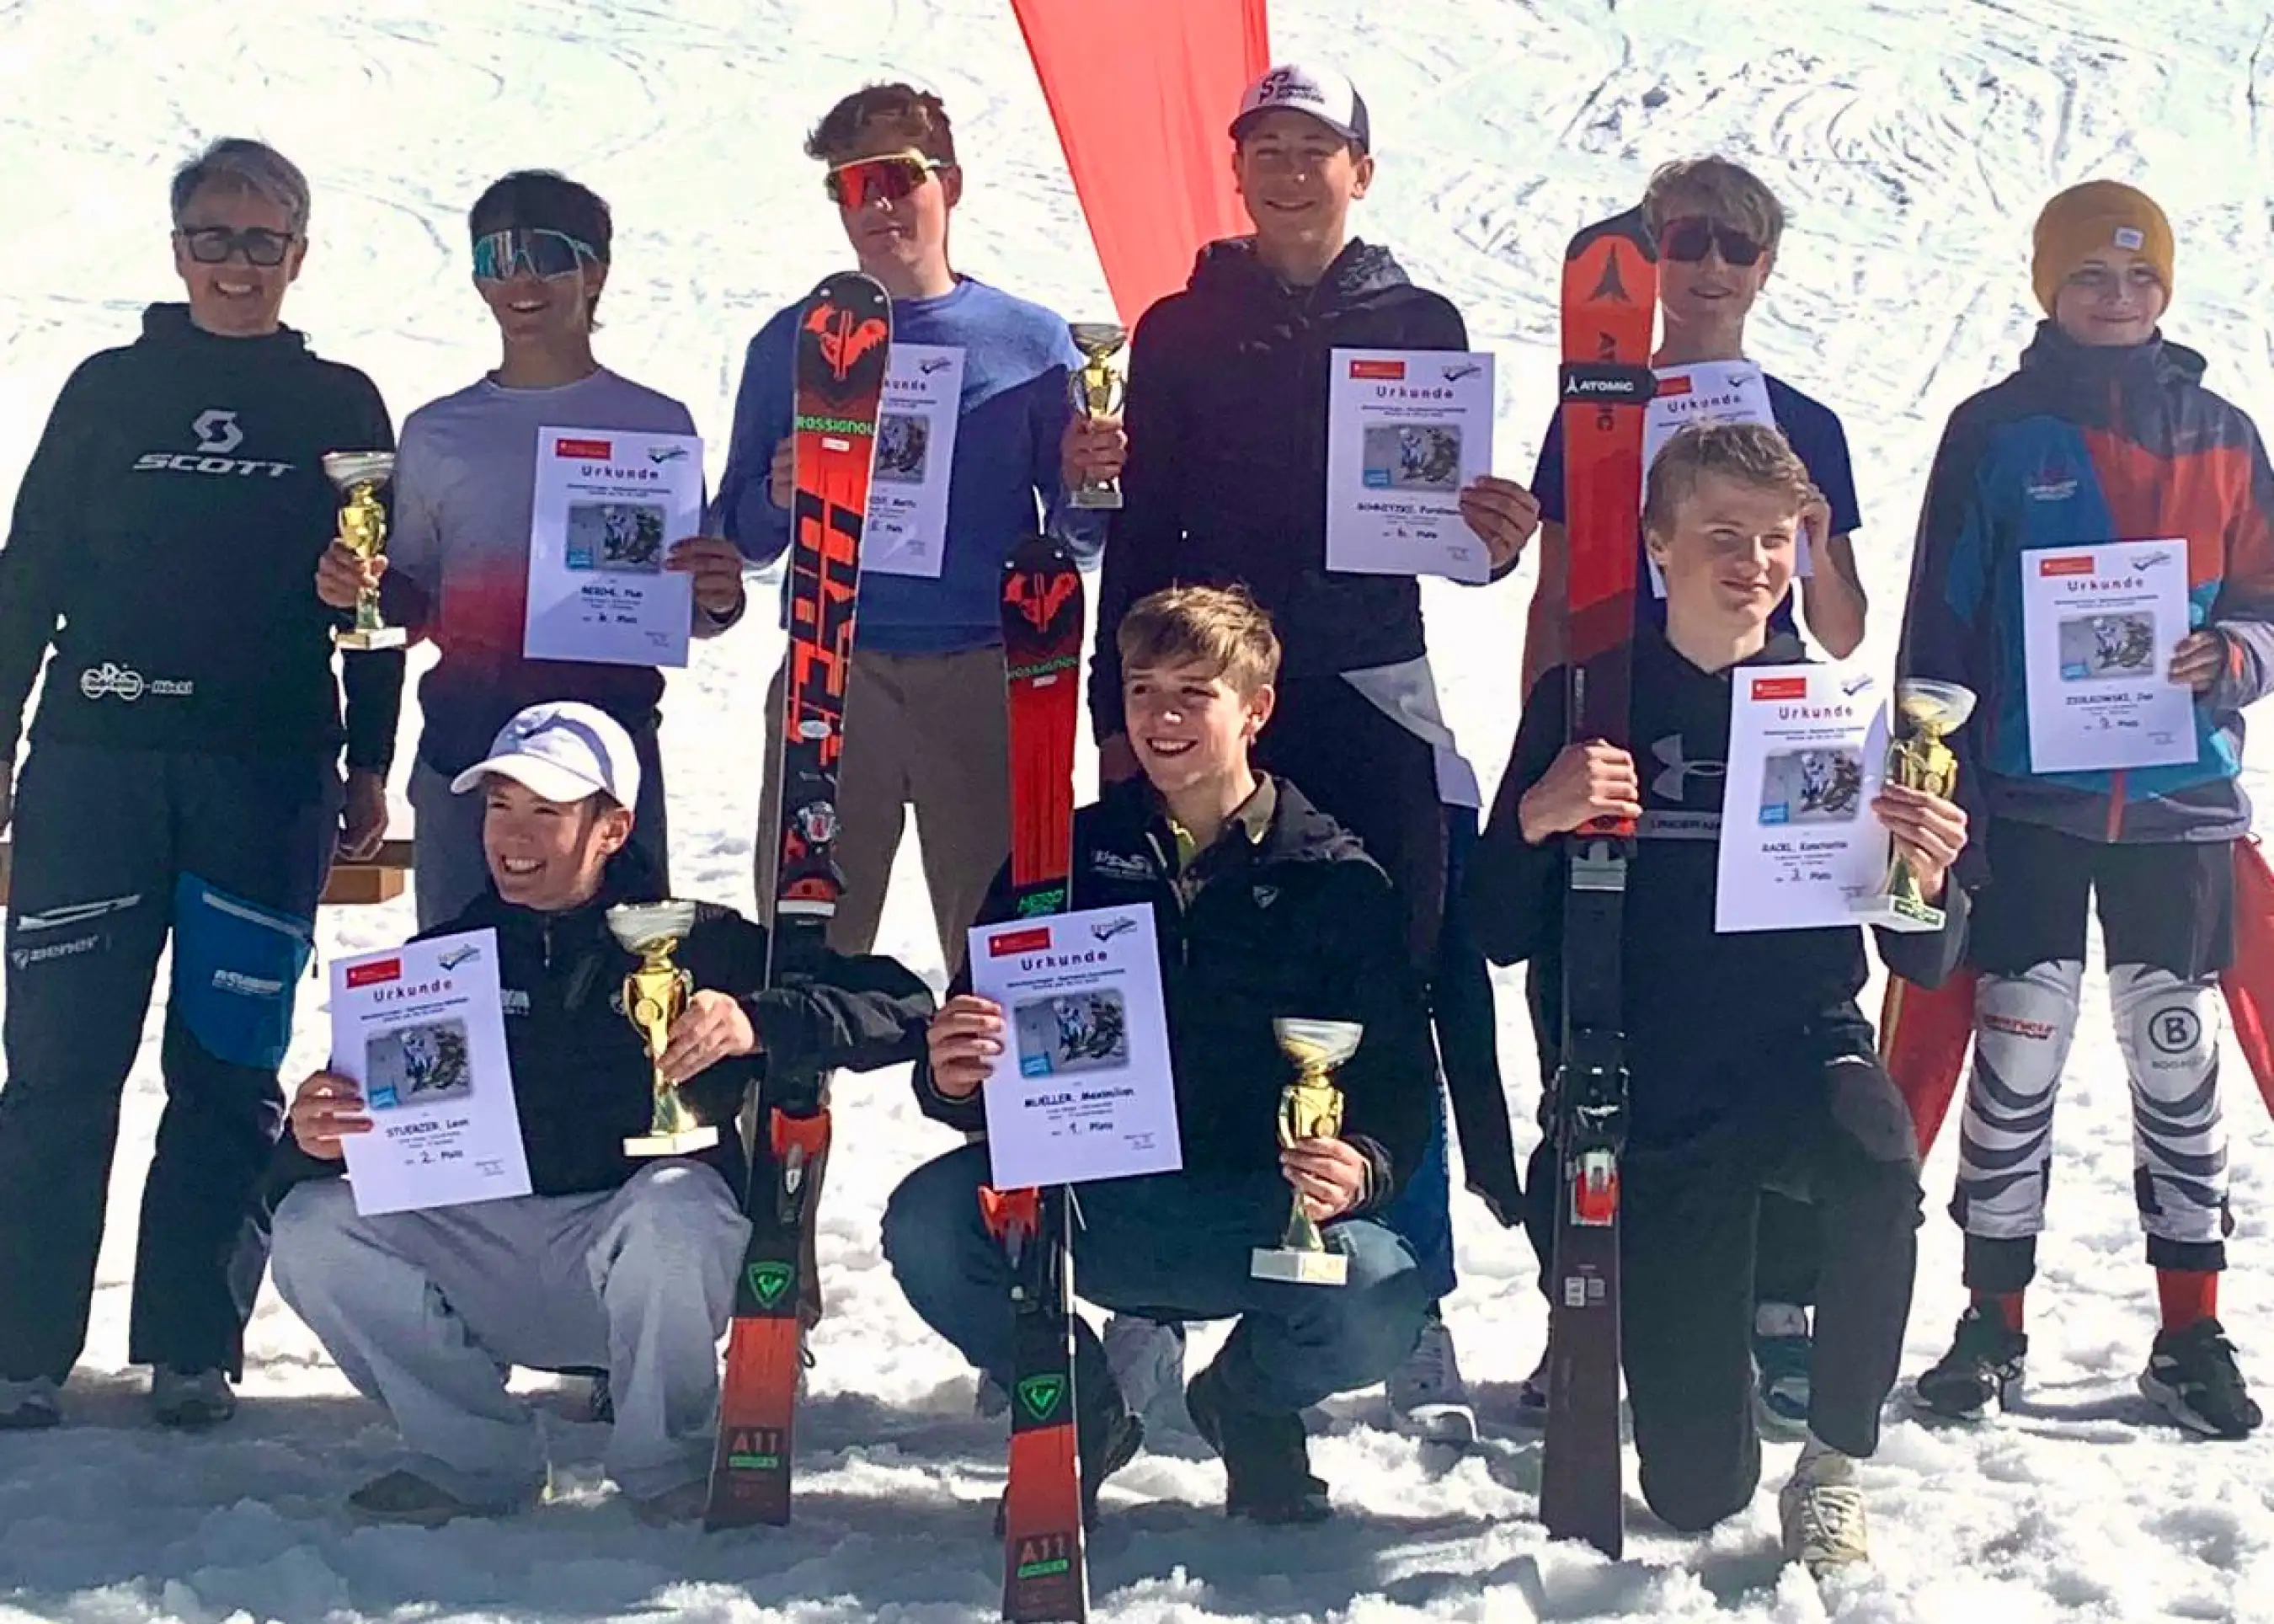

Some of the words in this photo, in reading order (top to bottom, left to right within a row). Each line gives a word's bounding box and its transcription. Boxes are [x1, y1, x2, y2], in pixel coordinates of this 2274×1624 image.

[1376, 385, 1454, 398] Urkunde
[1580, 378, 1634, 392] ATOMIC
[1667, 393, 1741, 413] Urkunde
[132, 454, 295, 477] SCOTT
[581, 465, 659, 480] Urkunde
[2067, 576, 2144, 591] Urkunde
[1778, 705, 1853, 720] Urkunde
[1020, 949, 1108, 971] Urkunde
[373, 978, 453, 1002] Urkunde
[2165, 1017, 2187, 1044] B
